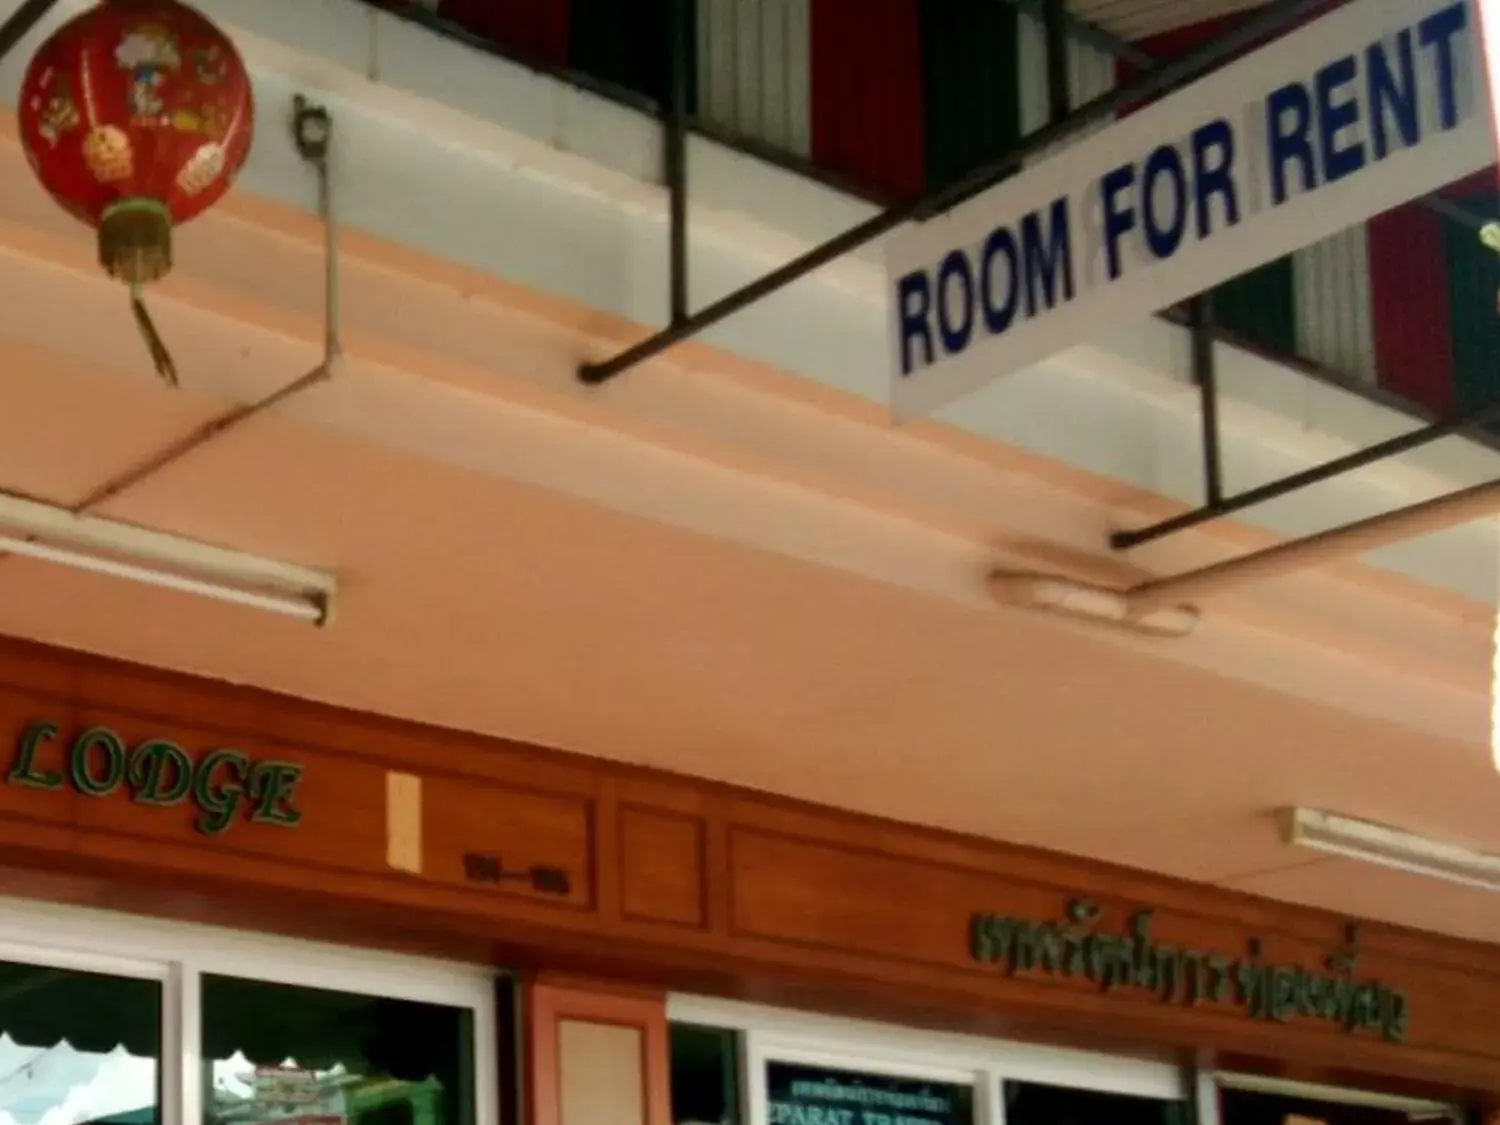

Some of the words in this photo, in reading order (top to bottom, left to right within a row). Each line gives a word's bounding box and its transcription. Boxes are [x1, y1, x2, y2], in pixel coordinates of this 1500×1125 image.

[896, 197, 1073, 376] ROOM
[1101, 120, 1238, 280] FOR
[1266, 3, 1466, 206] RENT
[8, 720, 303, 833] LODGE
